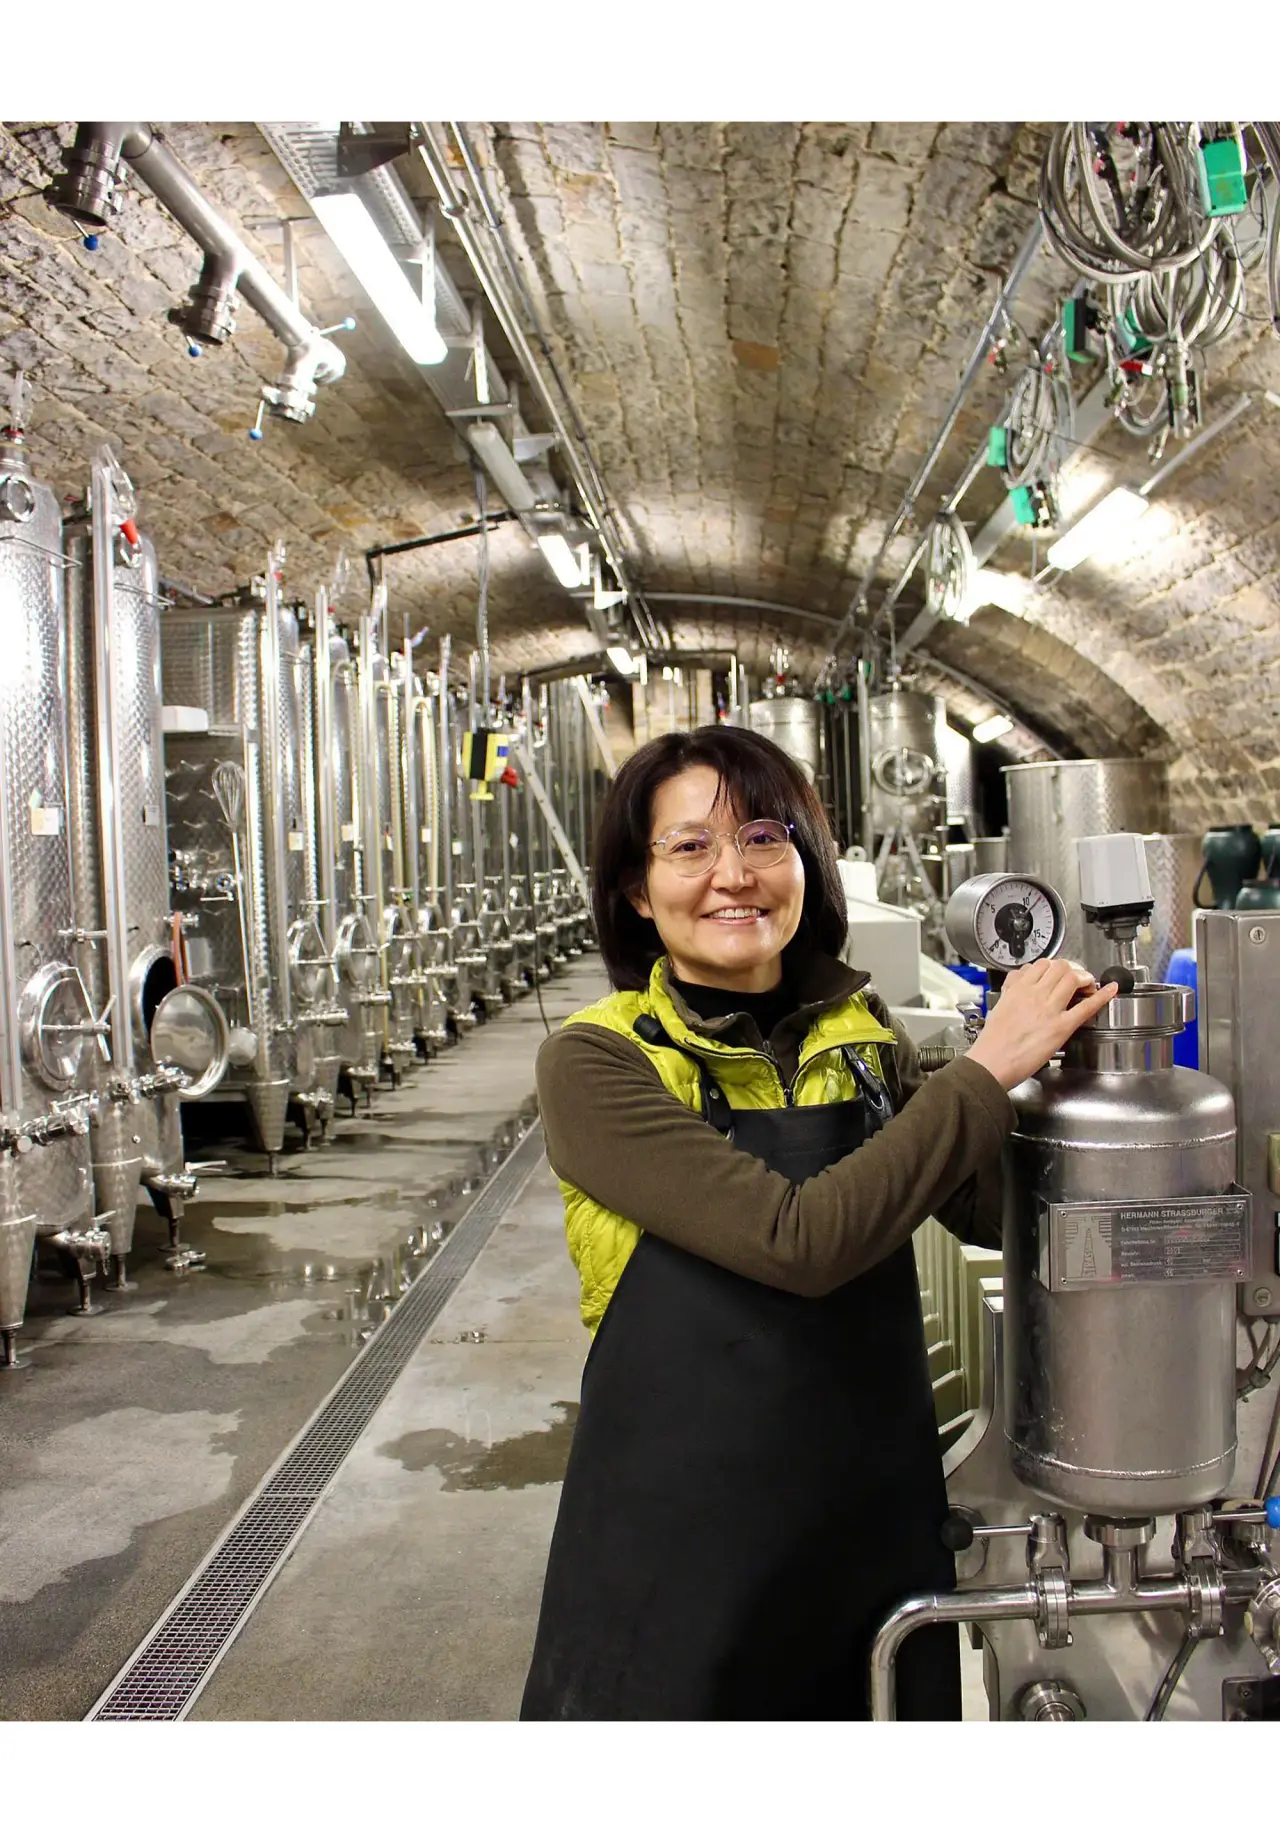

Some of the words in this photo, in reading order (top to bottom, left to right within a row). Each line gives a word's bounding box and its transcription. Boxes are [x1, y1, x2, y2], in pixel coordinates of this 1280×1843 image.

[1023, 897, 1030, 905] 10
[991, 905, 996, 913] 5
[1034, 929, 1041, 937] 15
[1120, 1211, 1159, 1220] HERMANN
[1161, 1208, 1224, 1218] STRASSBURGER
